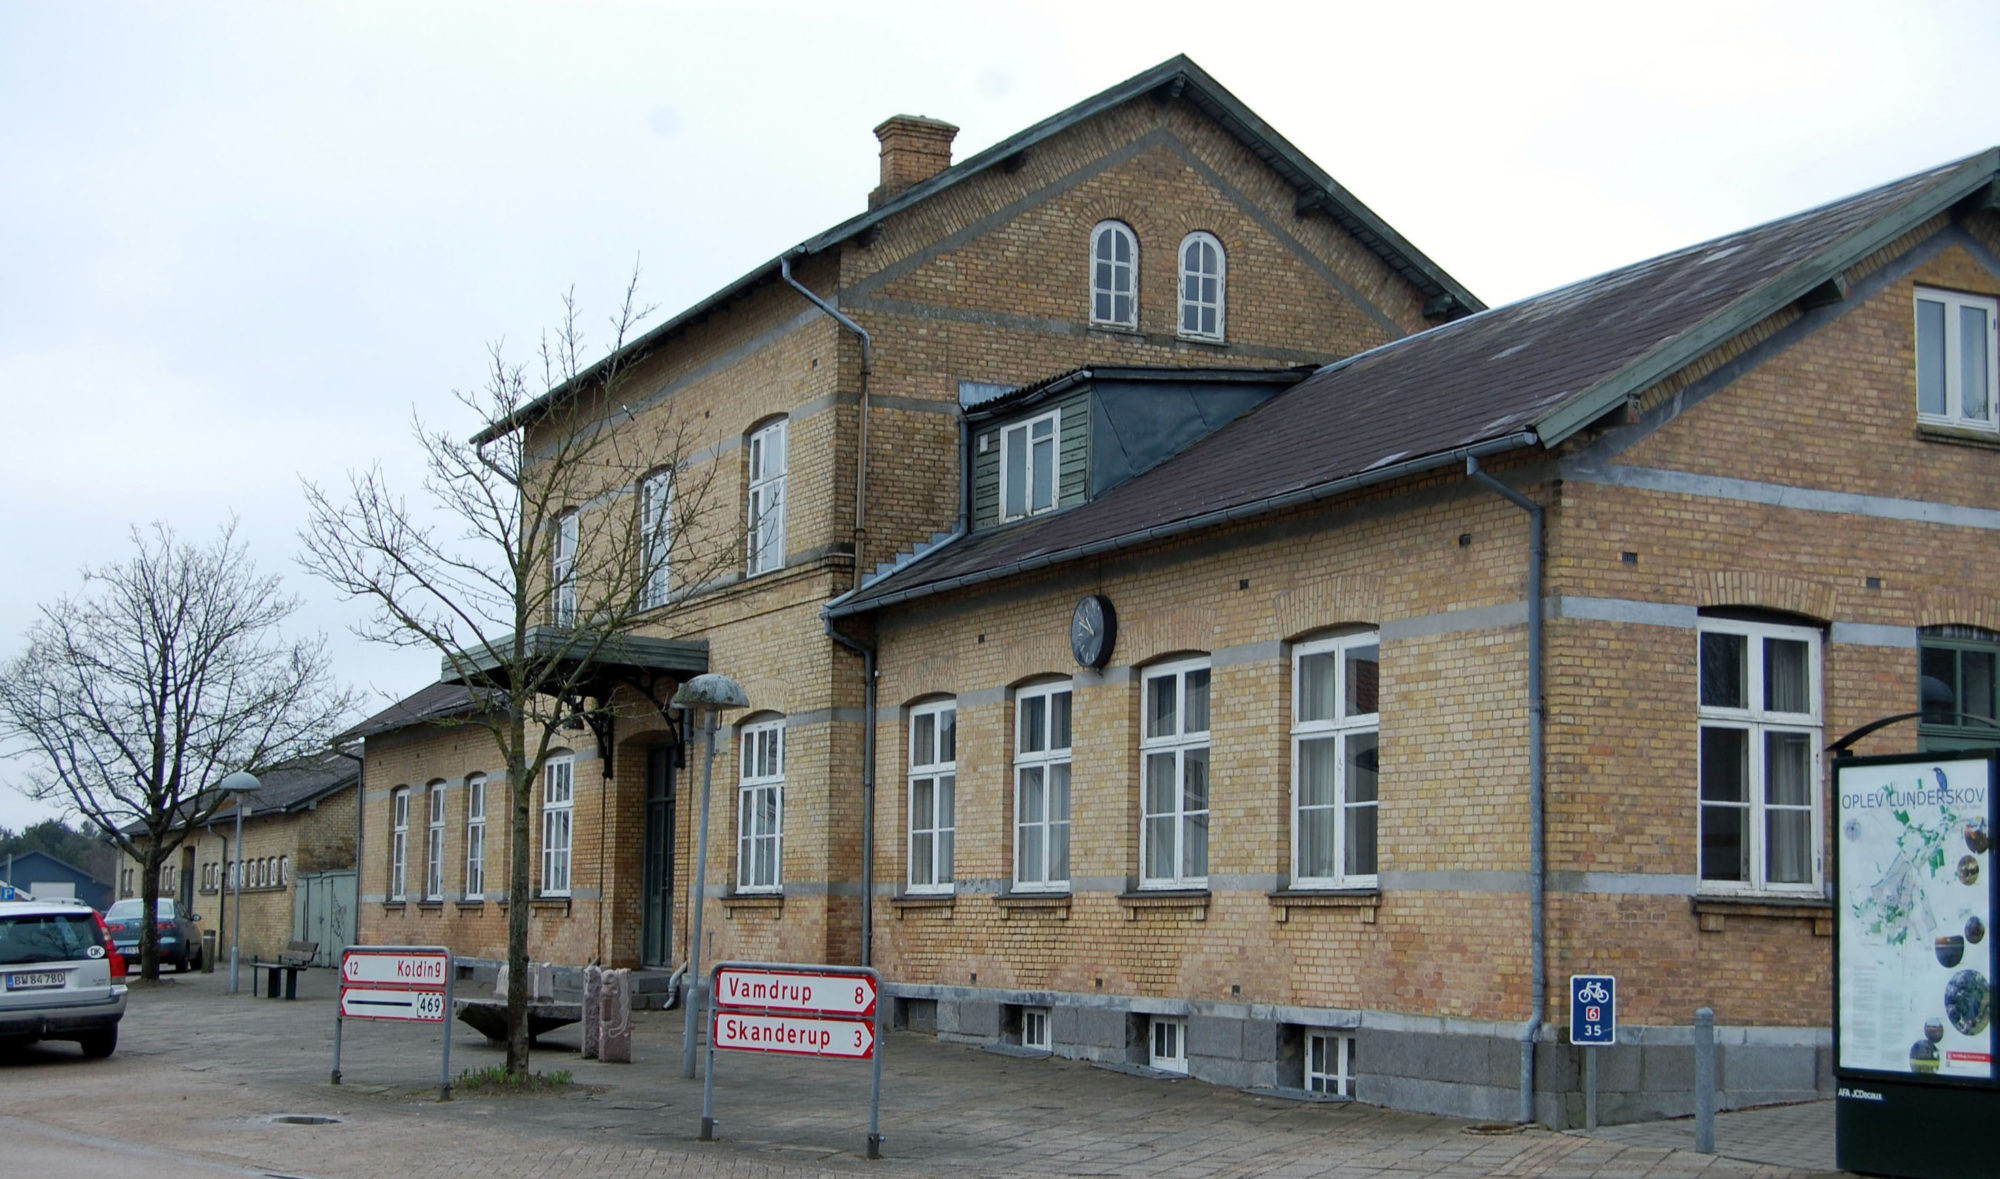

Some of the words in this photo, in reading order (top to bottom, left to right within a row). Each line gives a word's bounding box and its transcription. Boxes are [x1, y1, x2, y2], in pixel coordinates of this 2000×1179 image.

[1842, 793, 1883, 809] OPLEV
[1889, 788, 1985, 807] LUNDERSKOV
[4, 888, 13, 898] P
[90, 947, 102, 957] DK
[349, 961, 359, 975] 12
[397, 960, 441, 978] Kolding
[14, 975, 28, 985] BW
[30, 974, 42, 985] 84
[44, 973, 64, 984] 780
[729, 977, 812, 1005] Vamdrup
[854, 986, 864, 1004] 8
[420, 998, 440, 1013] 469
[1588, 1008, 1597, 1020] 6
[726, 1019, 831, 1049] Skanderup
[853, 1030, 862, 1048] 3
[1584, 1025, 1602, 1036] 35
